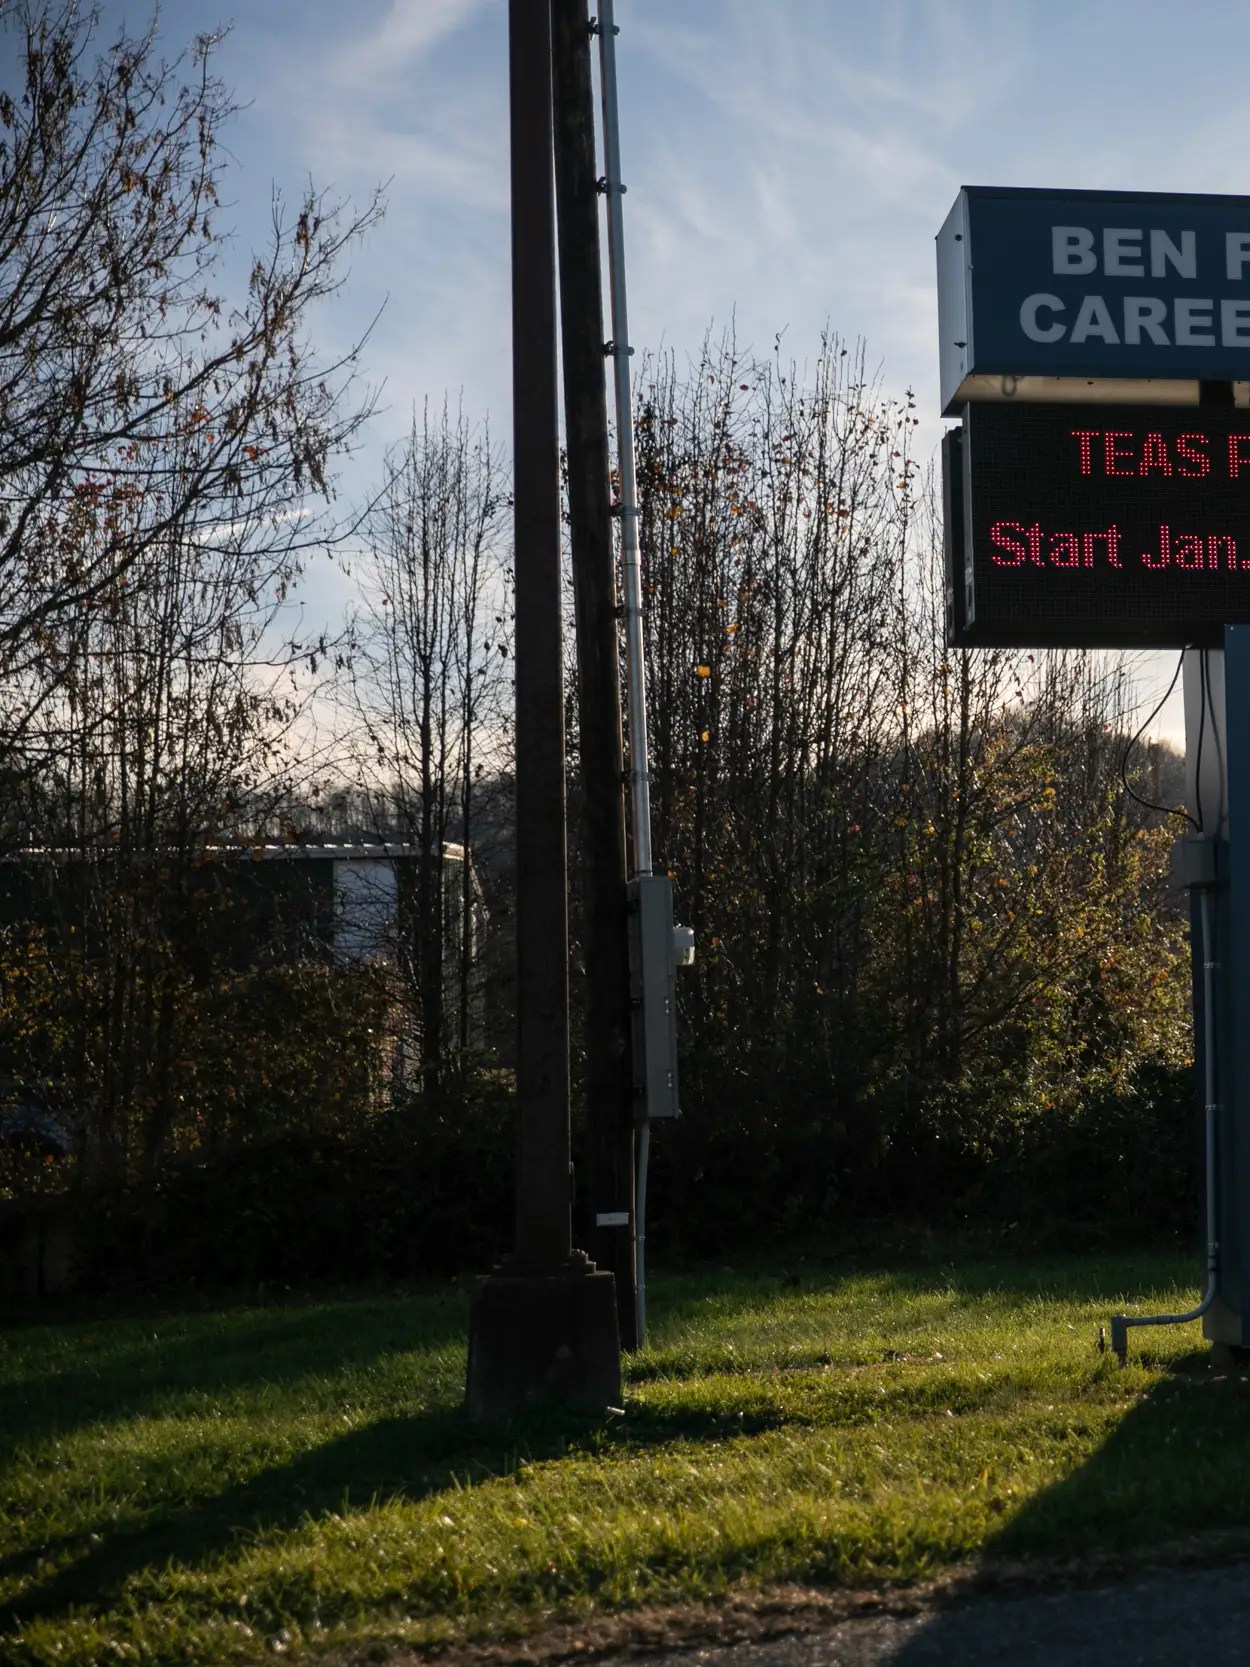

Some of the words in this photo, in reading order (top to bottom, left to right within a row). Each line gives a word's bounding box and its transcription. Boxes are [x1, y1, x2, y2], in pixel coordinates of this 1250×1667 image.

[1052, 226, 1197, 278] BEN
[1071, 430, 1210, 478] TEAS
[990, 521, 1122, 568] Start
